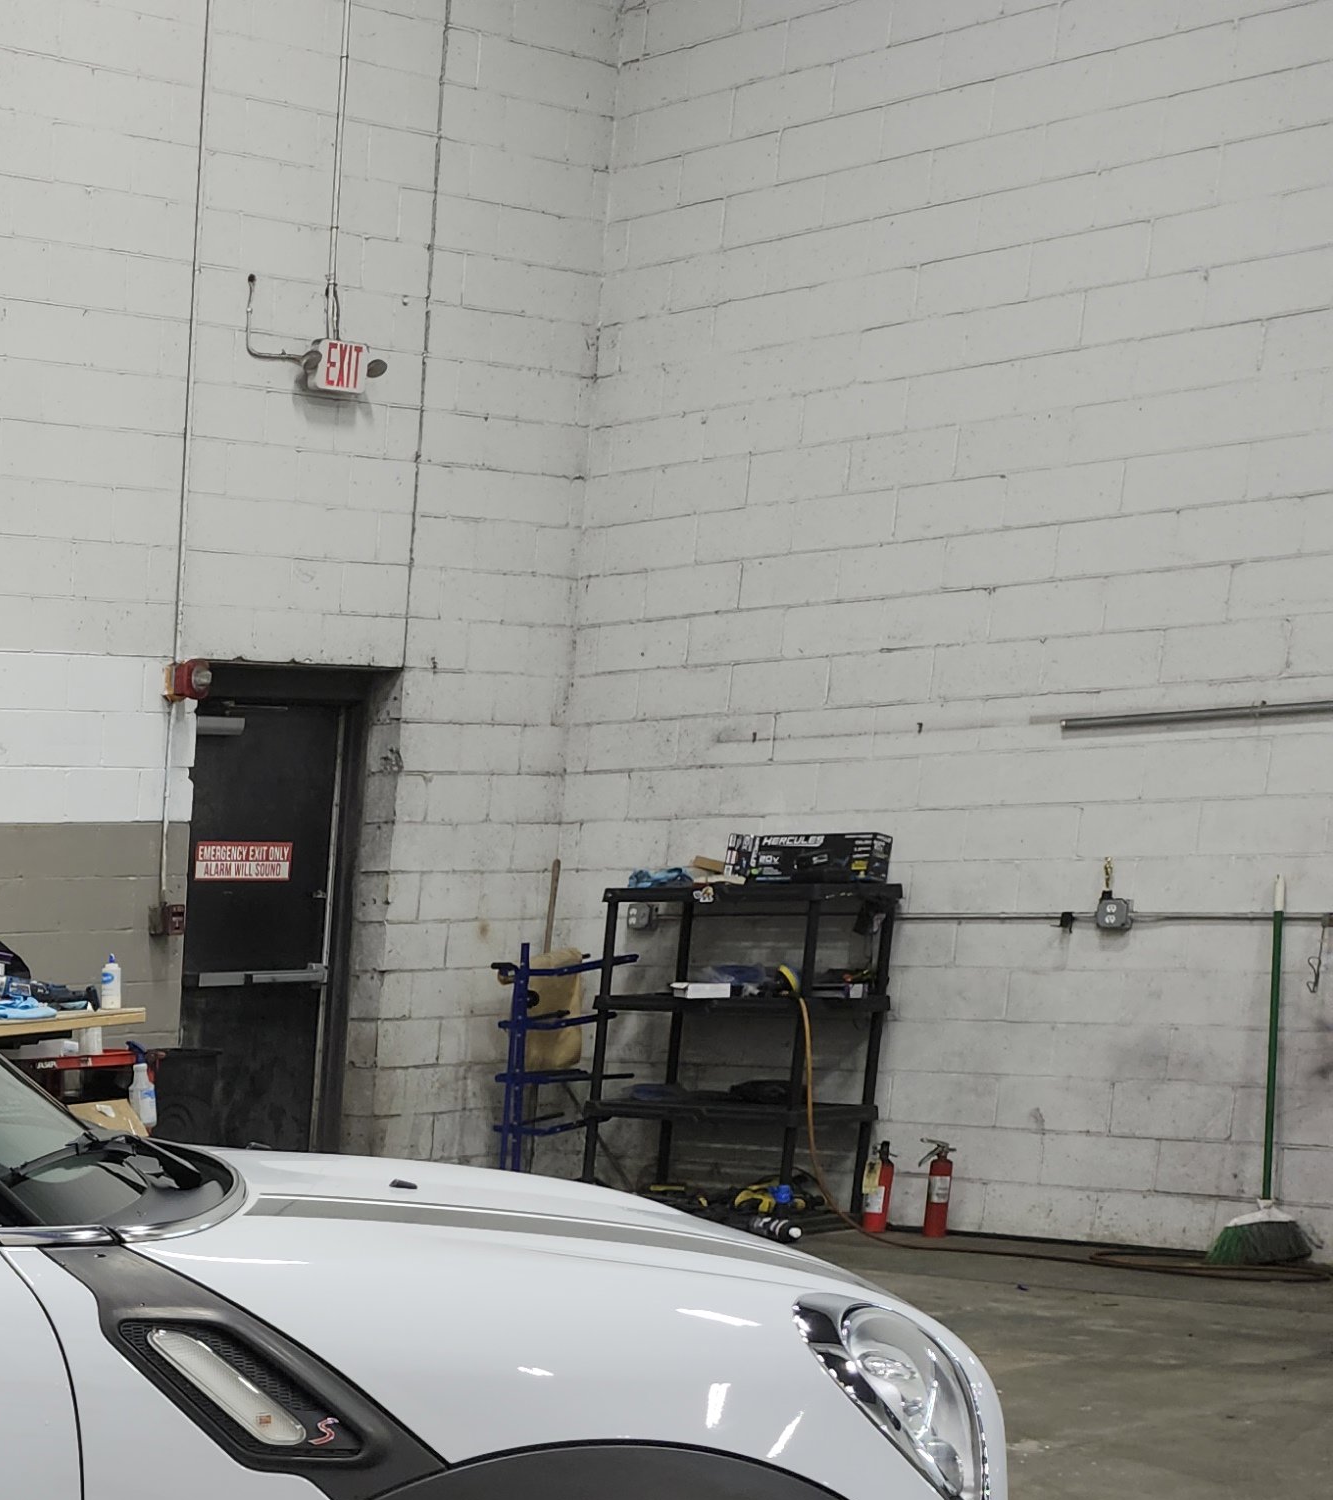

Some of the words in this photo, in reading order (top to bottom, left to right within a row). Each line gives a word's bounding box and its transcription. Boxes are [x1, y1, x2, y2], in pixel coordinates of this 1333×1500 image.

[326, 342, 364, 389] EXIT
[762, 835, 826, 847] HERCULES
[198, 845, 248, 861] EMERGENCY
[249, 846, 268, 861] EXIT
[268, 846, 290, 861] ONLY
[203, 862, 232, 877] ALARM
[234, 862, 253, 877] WILL
[254, 862, 282, 877] SOUND
[307, 1417, 340, 1446] S
